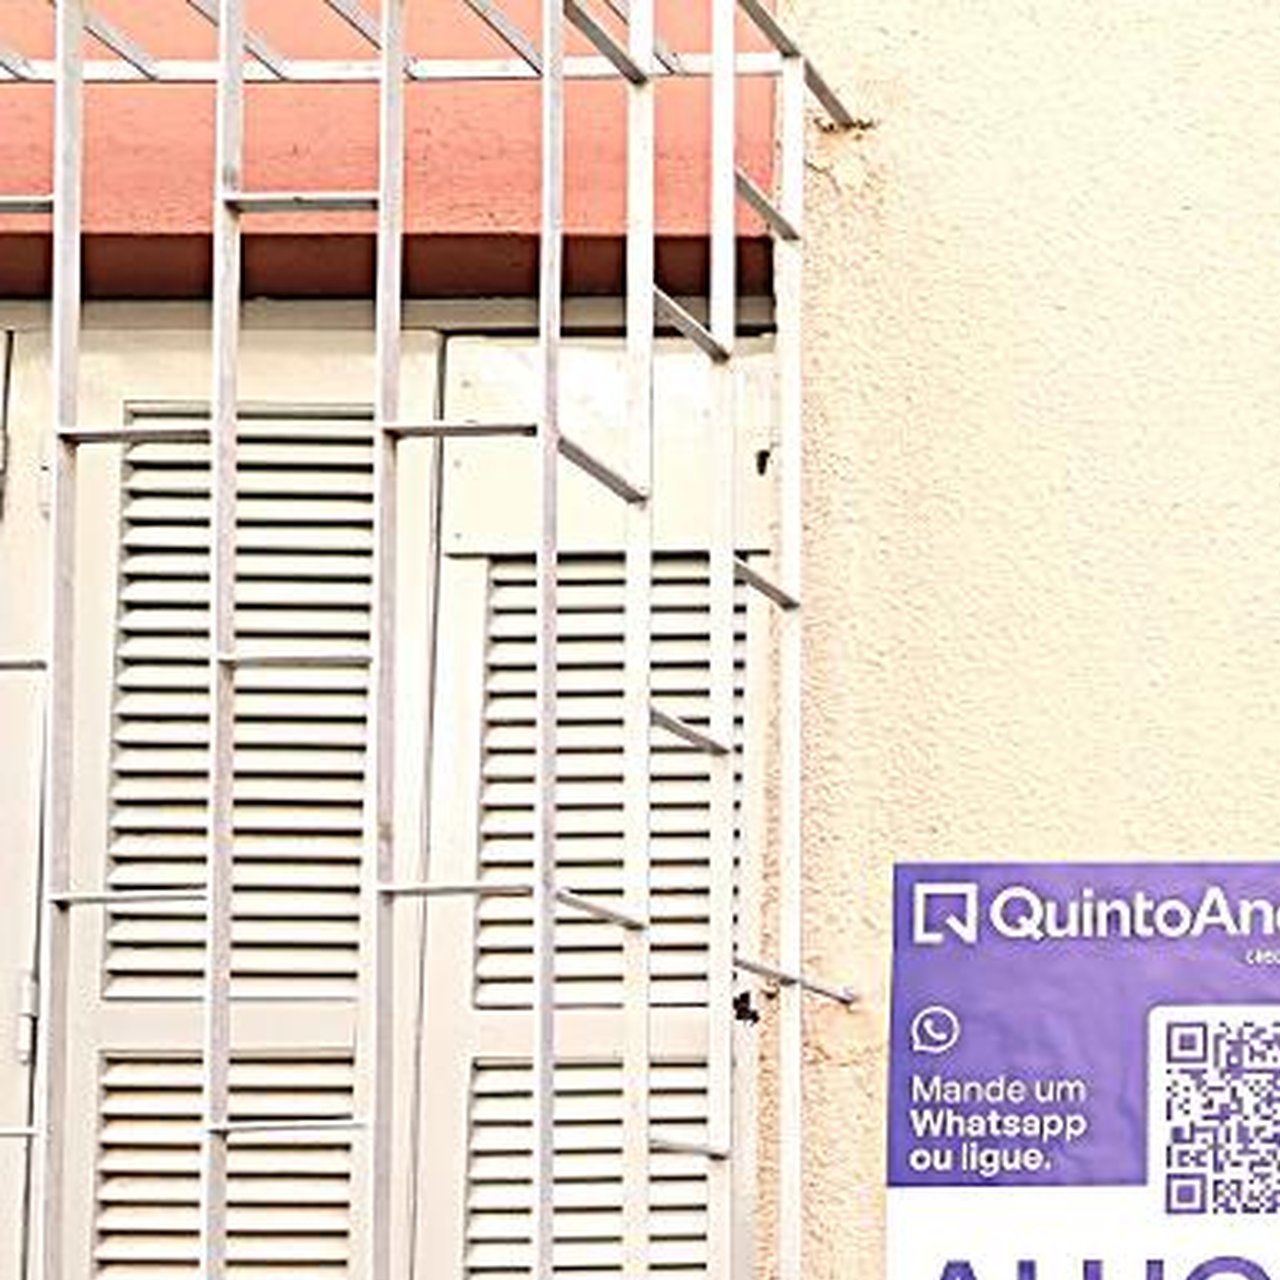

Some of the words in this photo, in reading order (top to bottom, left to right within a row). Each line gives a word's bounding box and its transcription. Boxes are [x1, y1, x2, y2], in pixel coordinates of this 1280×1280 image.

[911, 1075, 1025, 1103] Mande
[1034, 1082, 1087, 1103] um
[911, 1108, 1087, 1141] Whatsapp
[909, 1149, 951, 1172] ou
[960, 1143, 1053, 1178] ligue.
